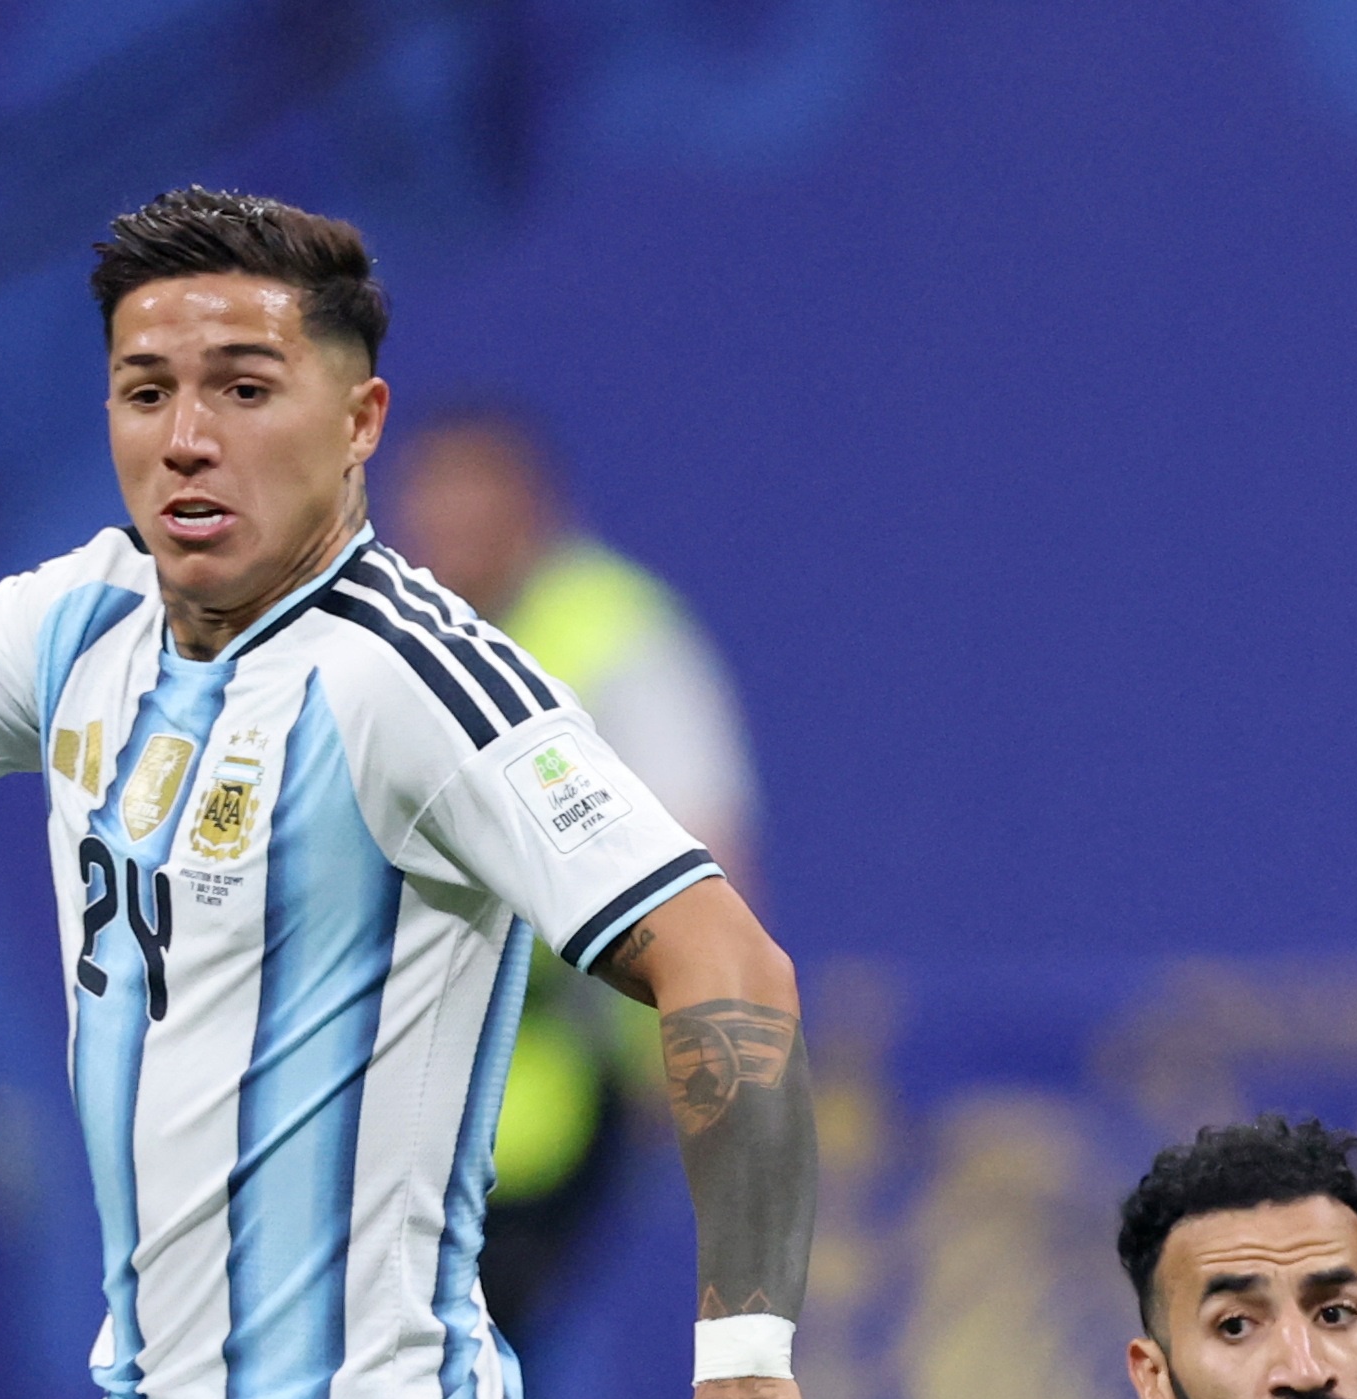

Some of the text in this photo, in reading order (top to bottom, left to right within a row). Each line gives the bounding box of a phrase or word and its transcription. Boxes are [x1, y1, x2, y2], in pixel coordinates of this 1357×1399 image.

[203, 784, 243, 832] AFA
[552, 788, 612, 832] EDUCATION
[581, 812, 605, 831] FIFA
[77, 835, 173, 1022] 24
